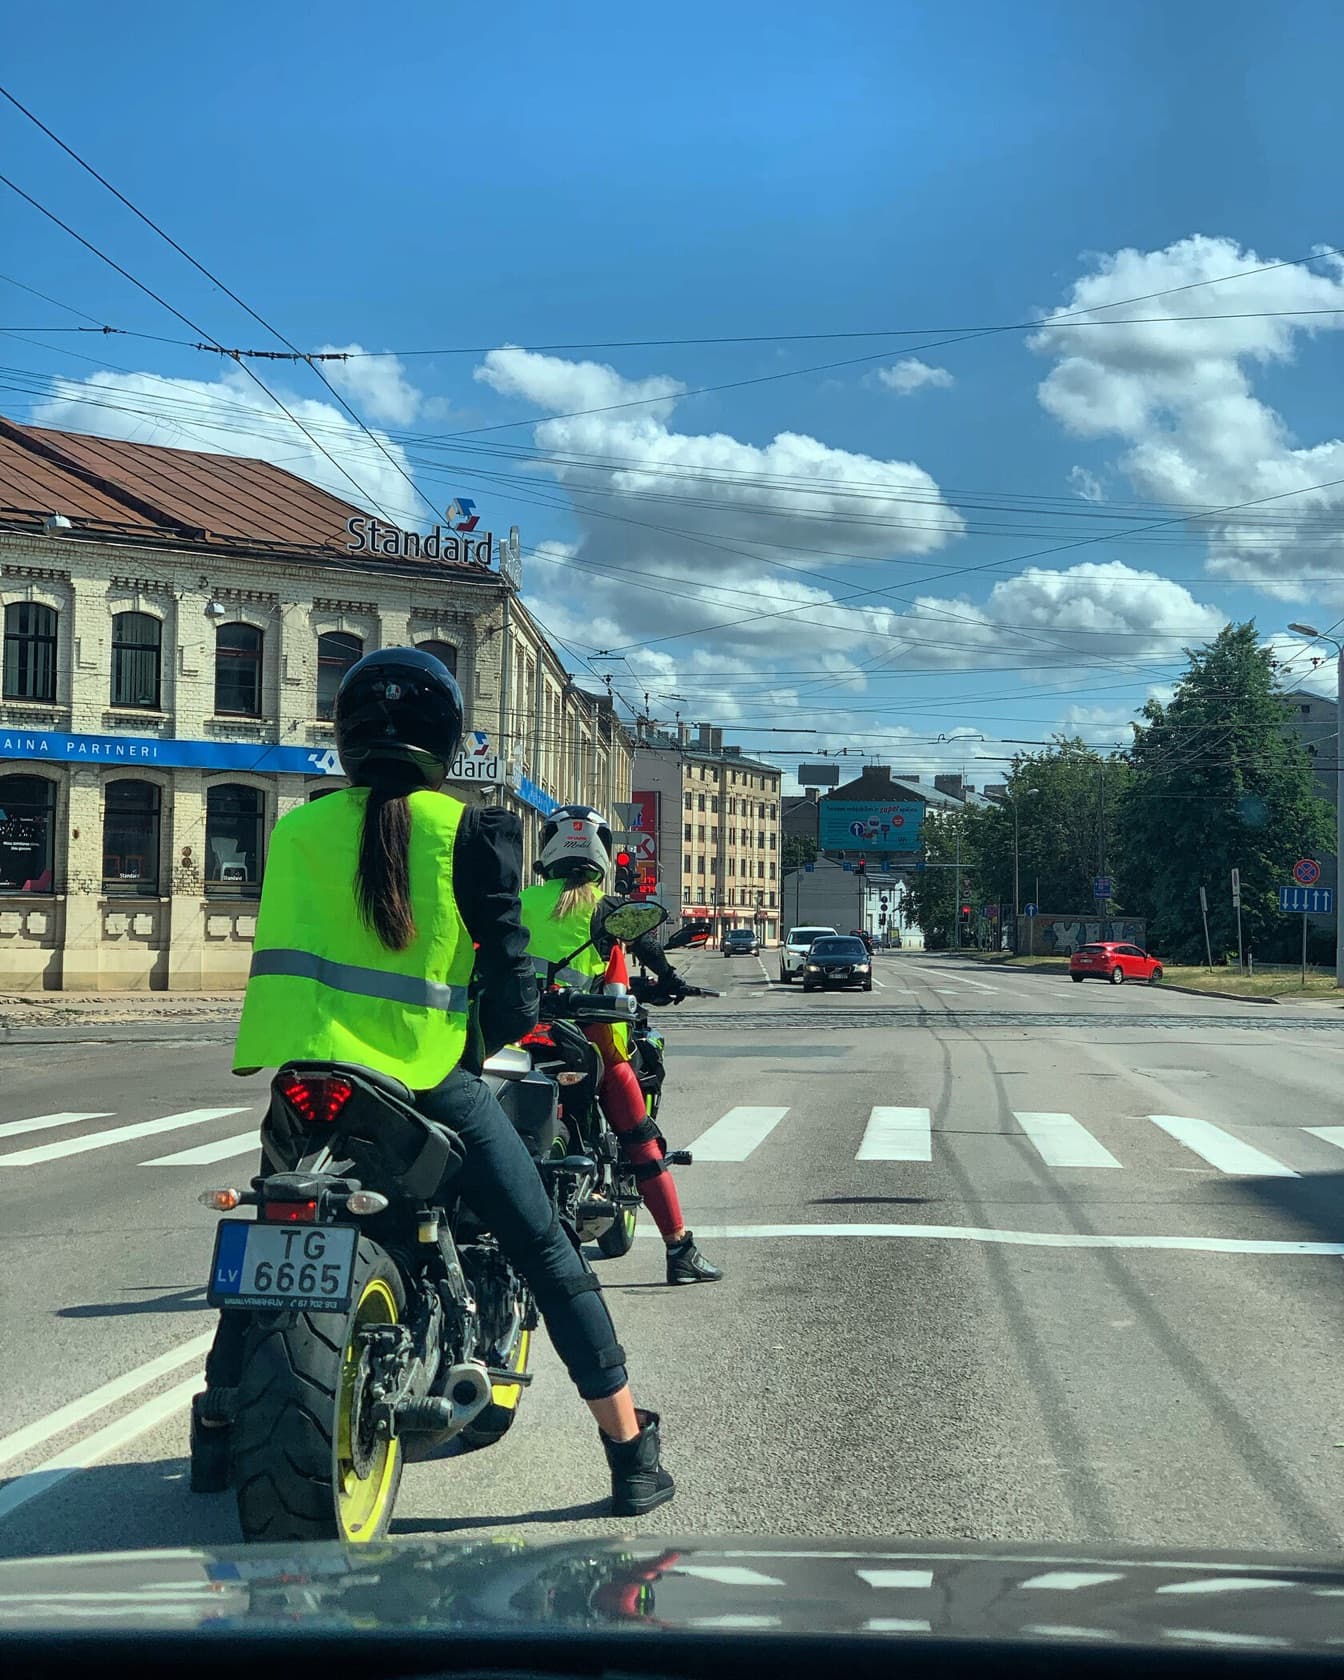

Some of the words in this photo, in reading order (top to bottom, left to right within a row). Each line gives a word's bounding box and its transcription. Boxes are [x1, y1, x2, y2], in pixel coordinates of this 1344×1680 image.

[347, 516, 493, 566] Standard
[4, 738, 49, 751] AINA
[66, 742, 158, 758] PARTNERI
[451, 752, 498, 779] dard
[280, 1229, 326, 1260] TG
[217, 1269, 239, 1283] LV
[254, 1261, 341, 1295] 6665
